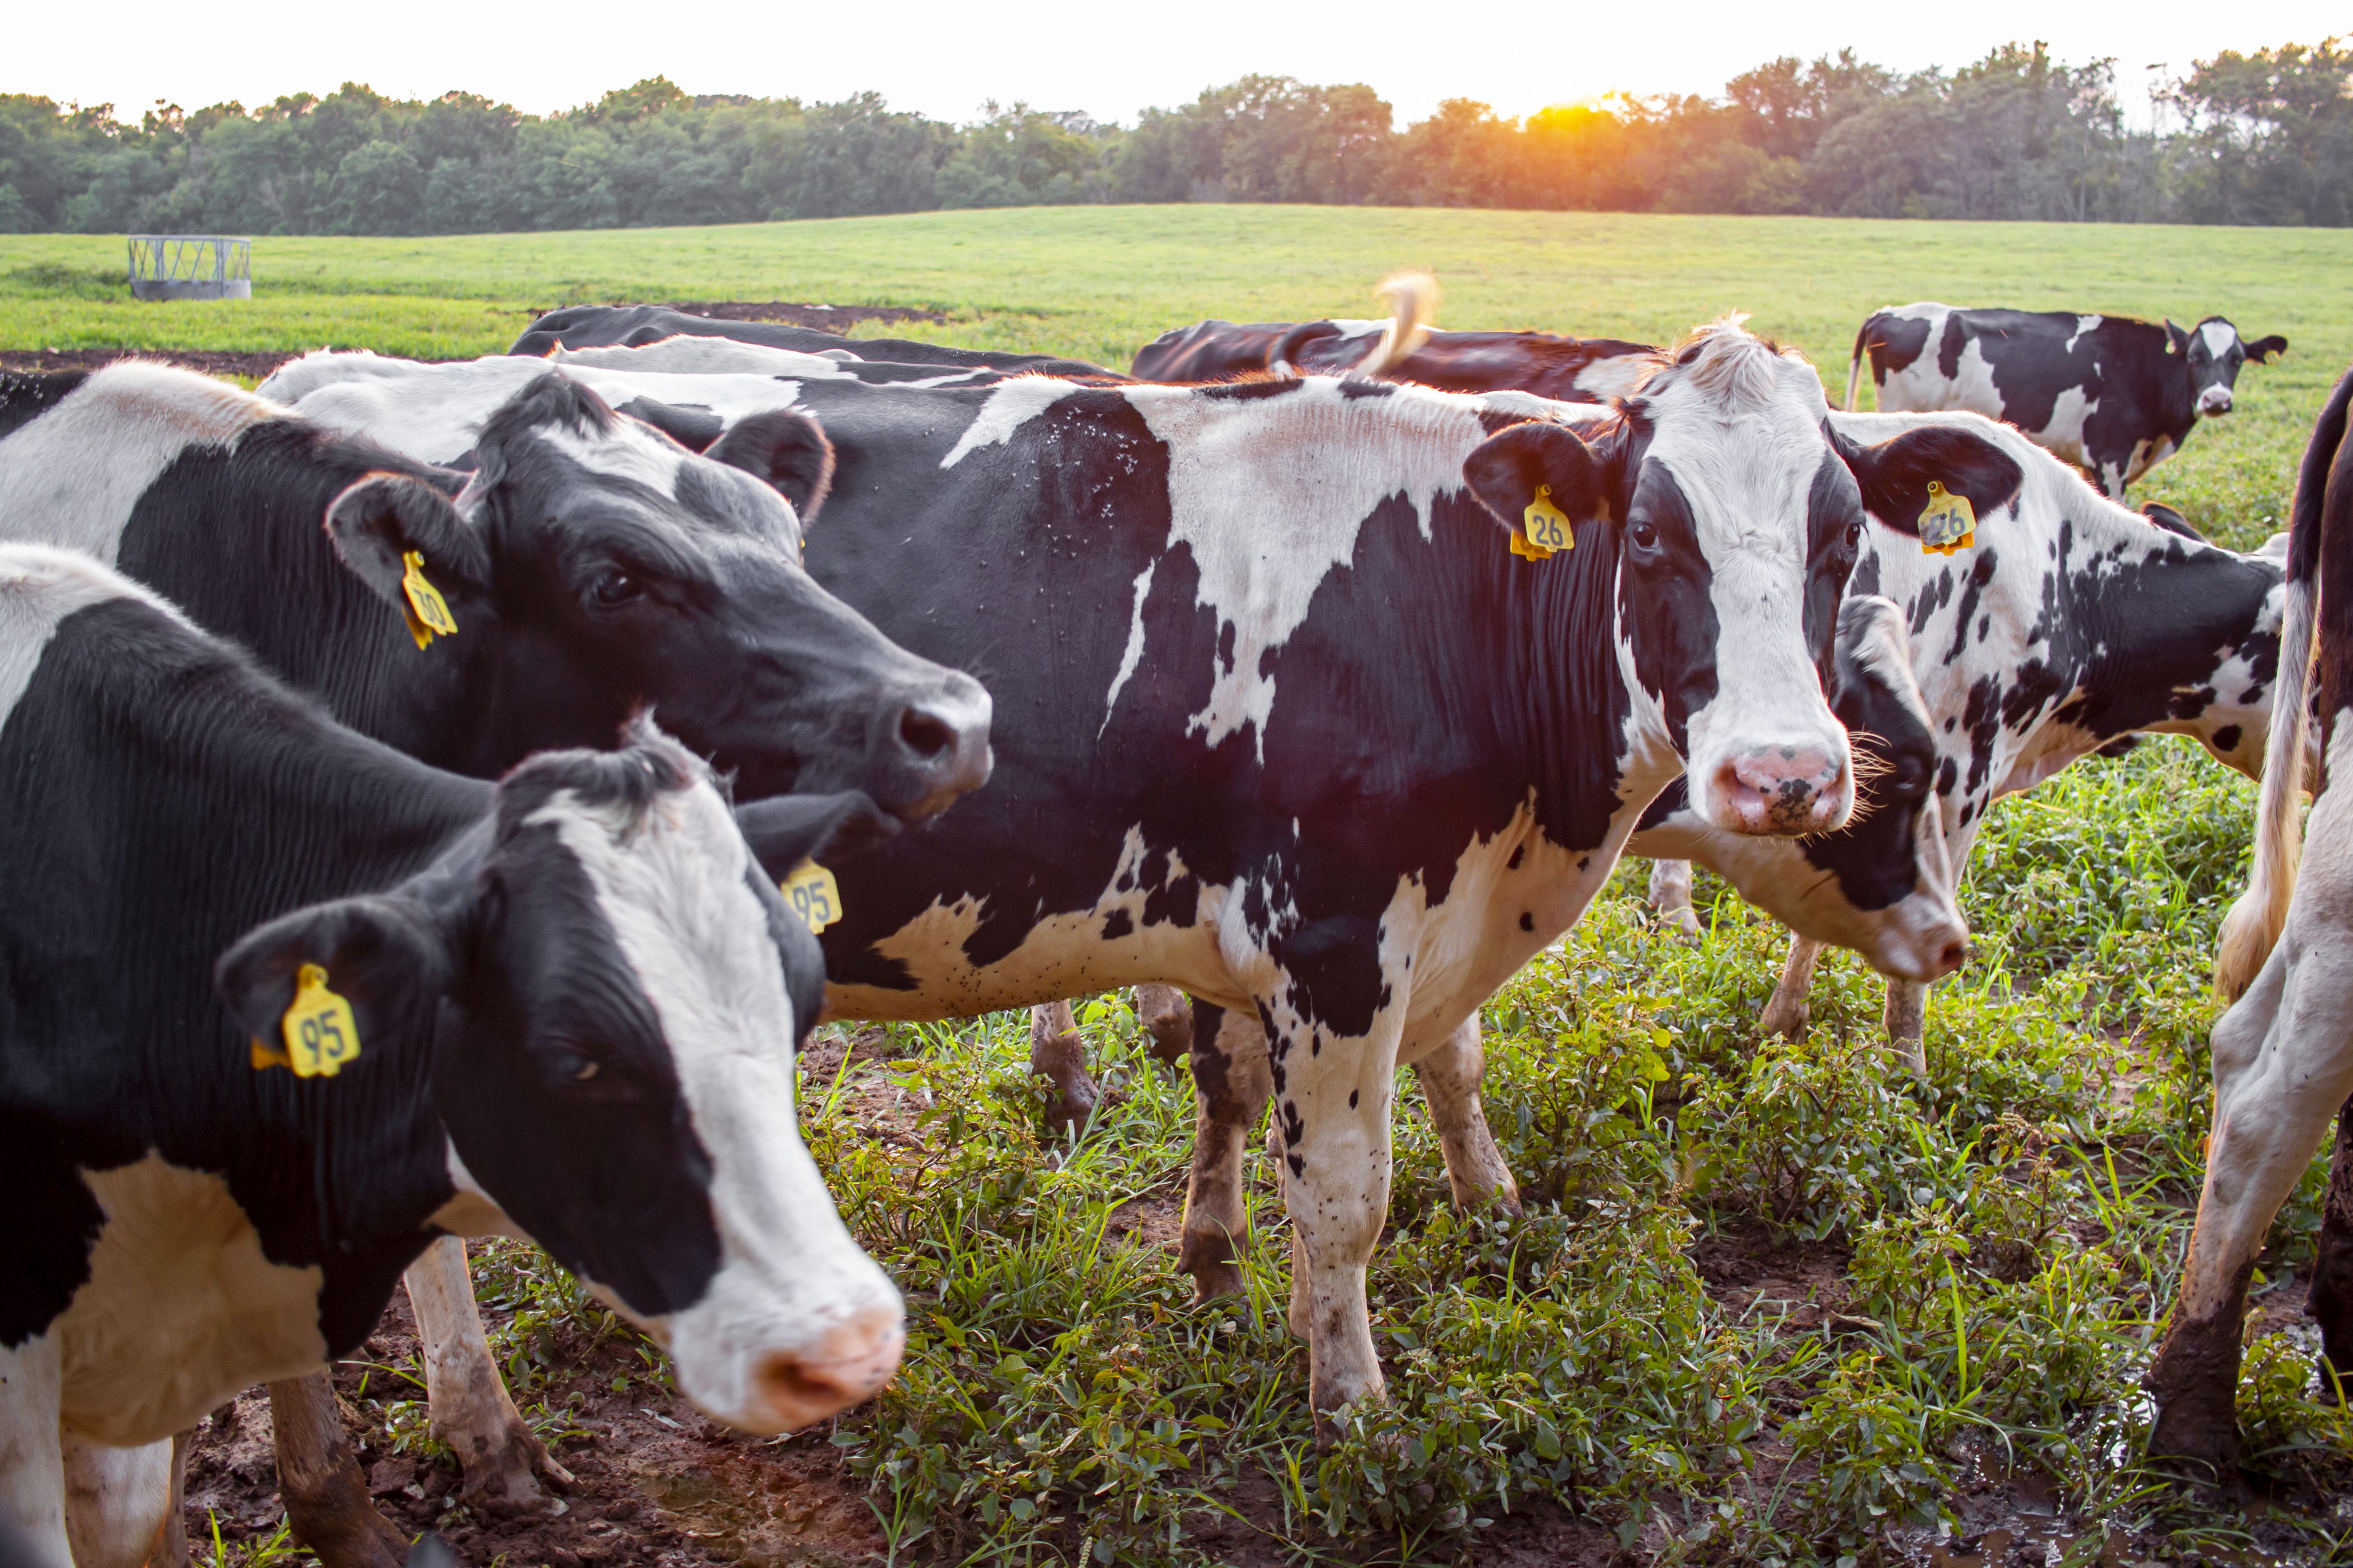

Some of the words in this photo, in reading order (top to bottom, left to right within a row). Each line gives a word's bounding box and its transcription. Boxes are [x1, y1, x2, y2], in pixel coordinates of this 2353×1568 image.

[1533, 515, 1563, 546] 26
[1928, 507, 1966, 544] 26
[793, 881, 831, 923] 95
[300, 1009, 346, 1065] 95
